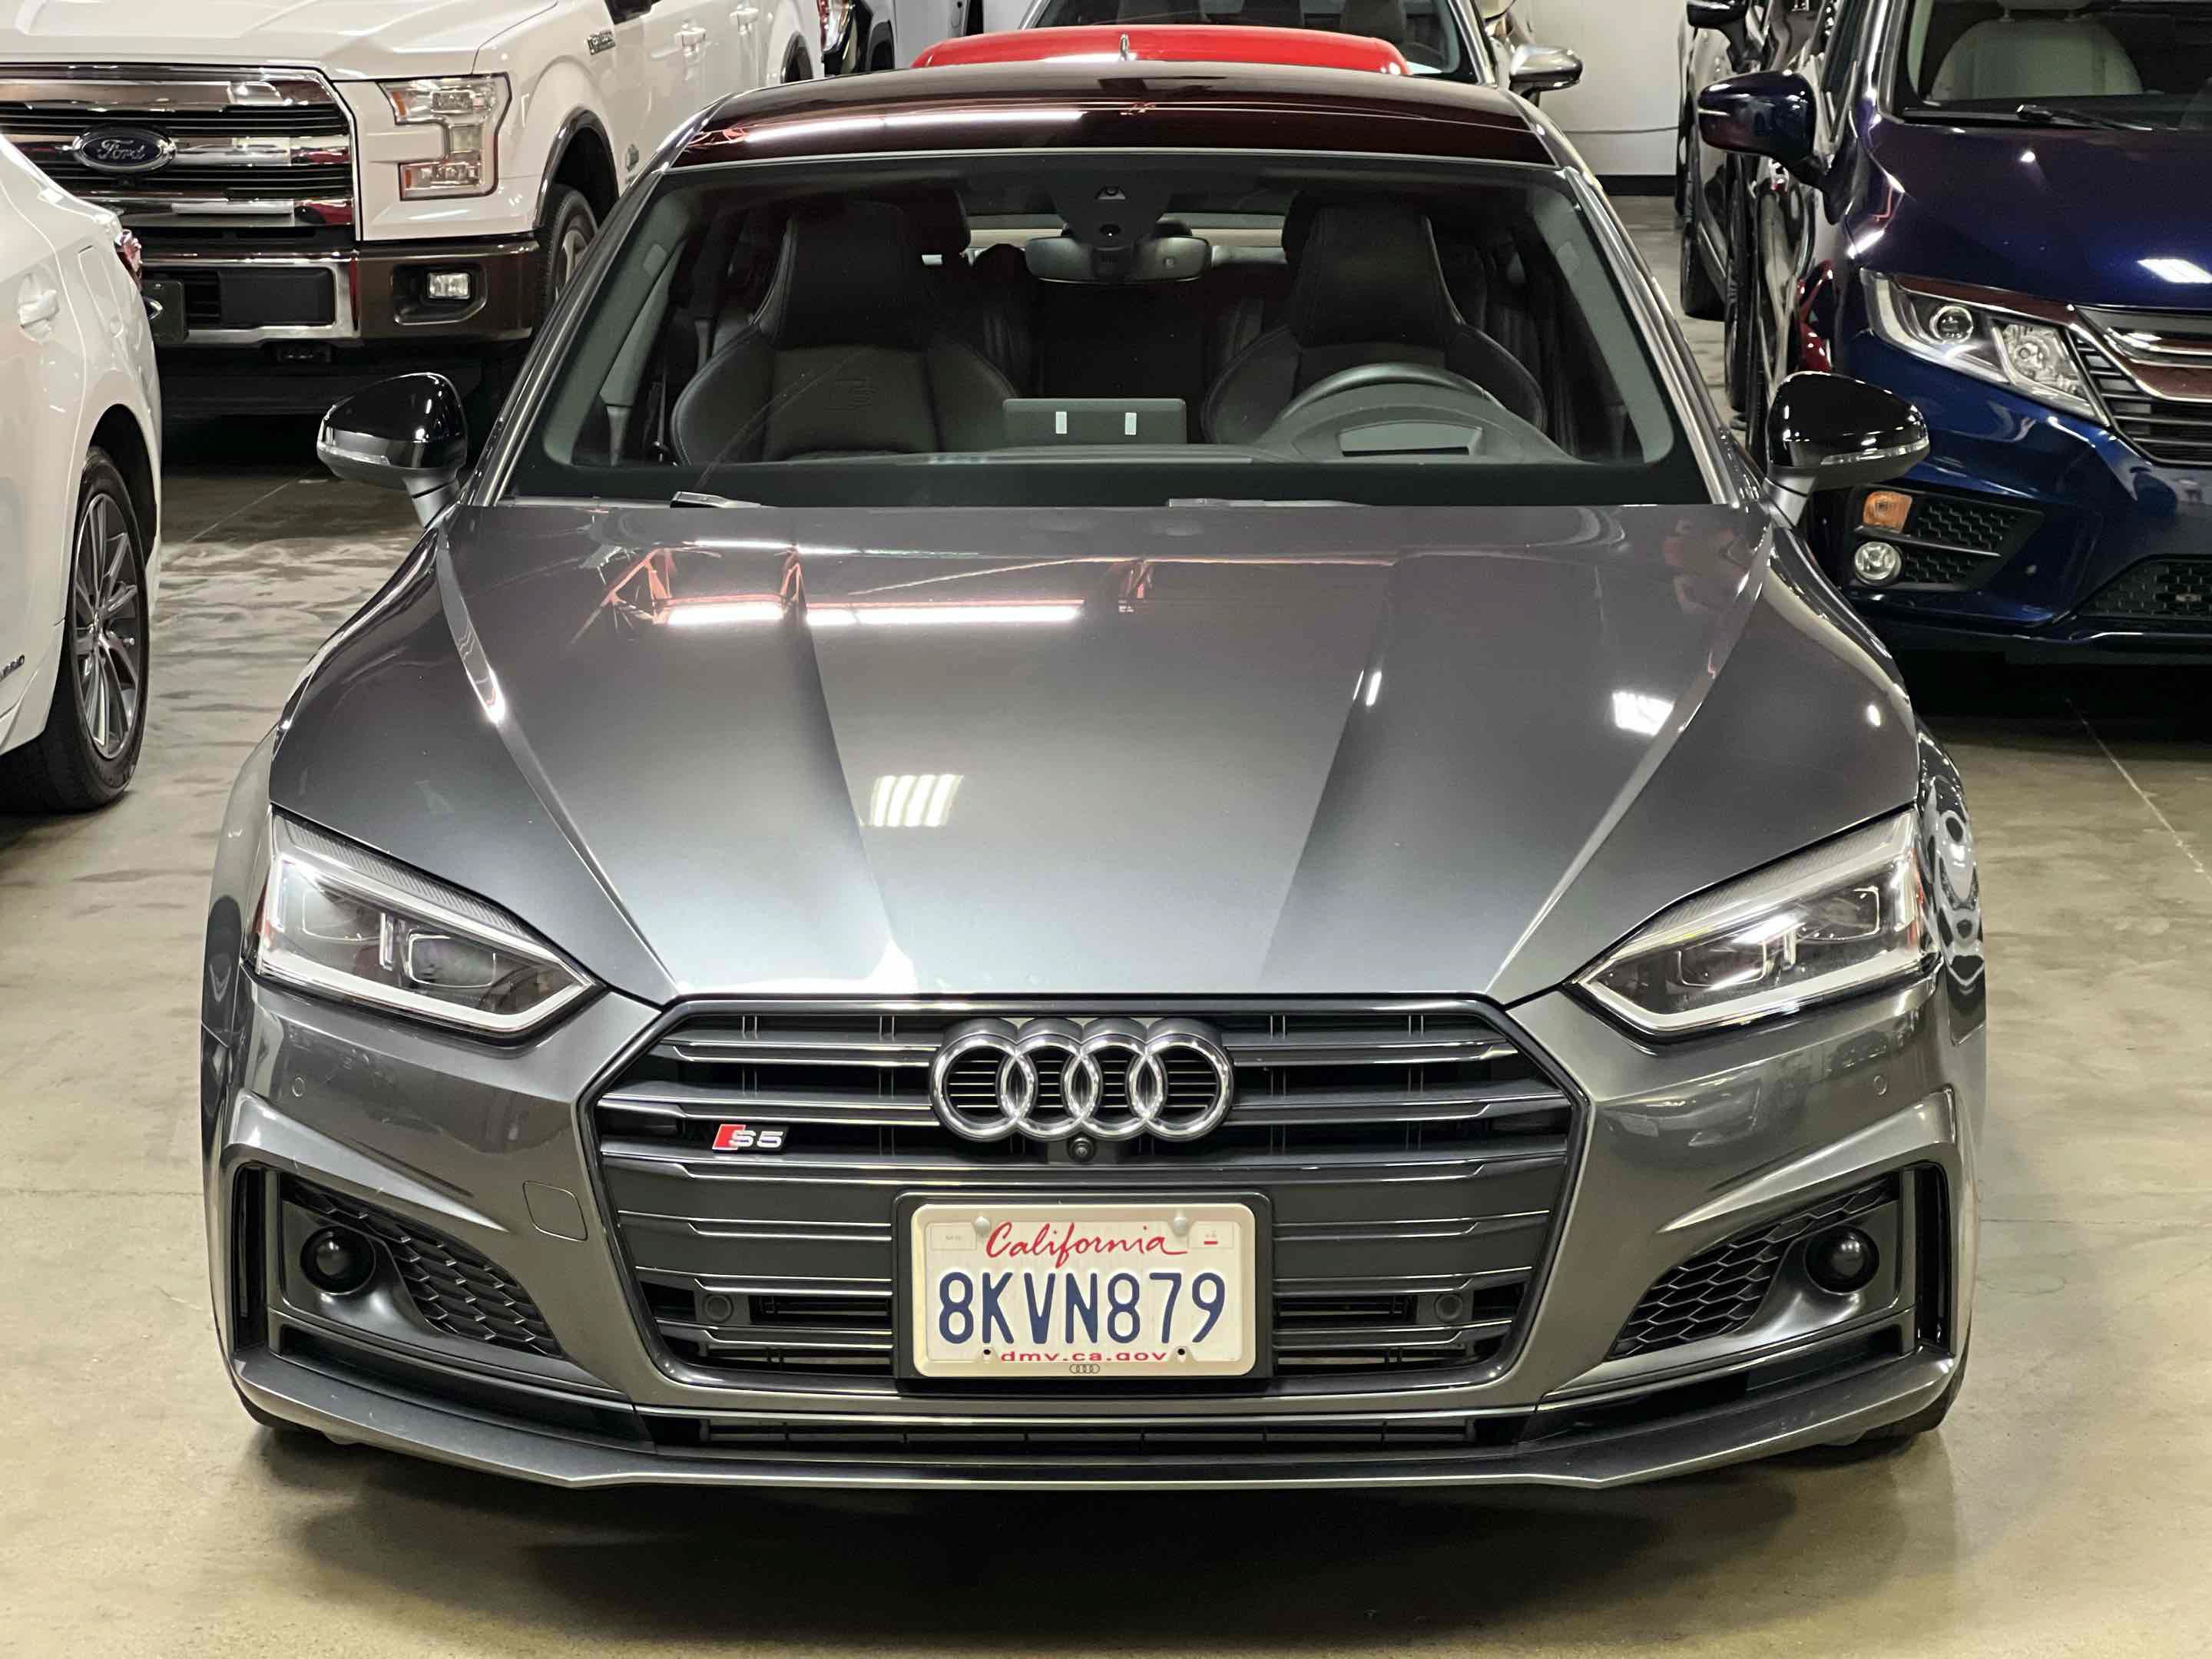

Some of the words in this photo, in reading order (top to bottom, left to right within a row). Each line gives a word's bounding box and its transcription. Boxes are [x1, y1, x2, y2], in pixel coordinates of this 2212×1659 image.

[98, 139, 146, 160] Ford
[728, 1129, 784, 1148] S5
[985, 1222, 1189, 1268] California
[939, 1272, 1226, 1344] 8KVN879
[1001, 1350, 1167, 1362] dmv.ca.gov
